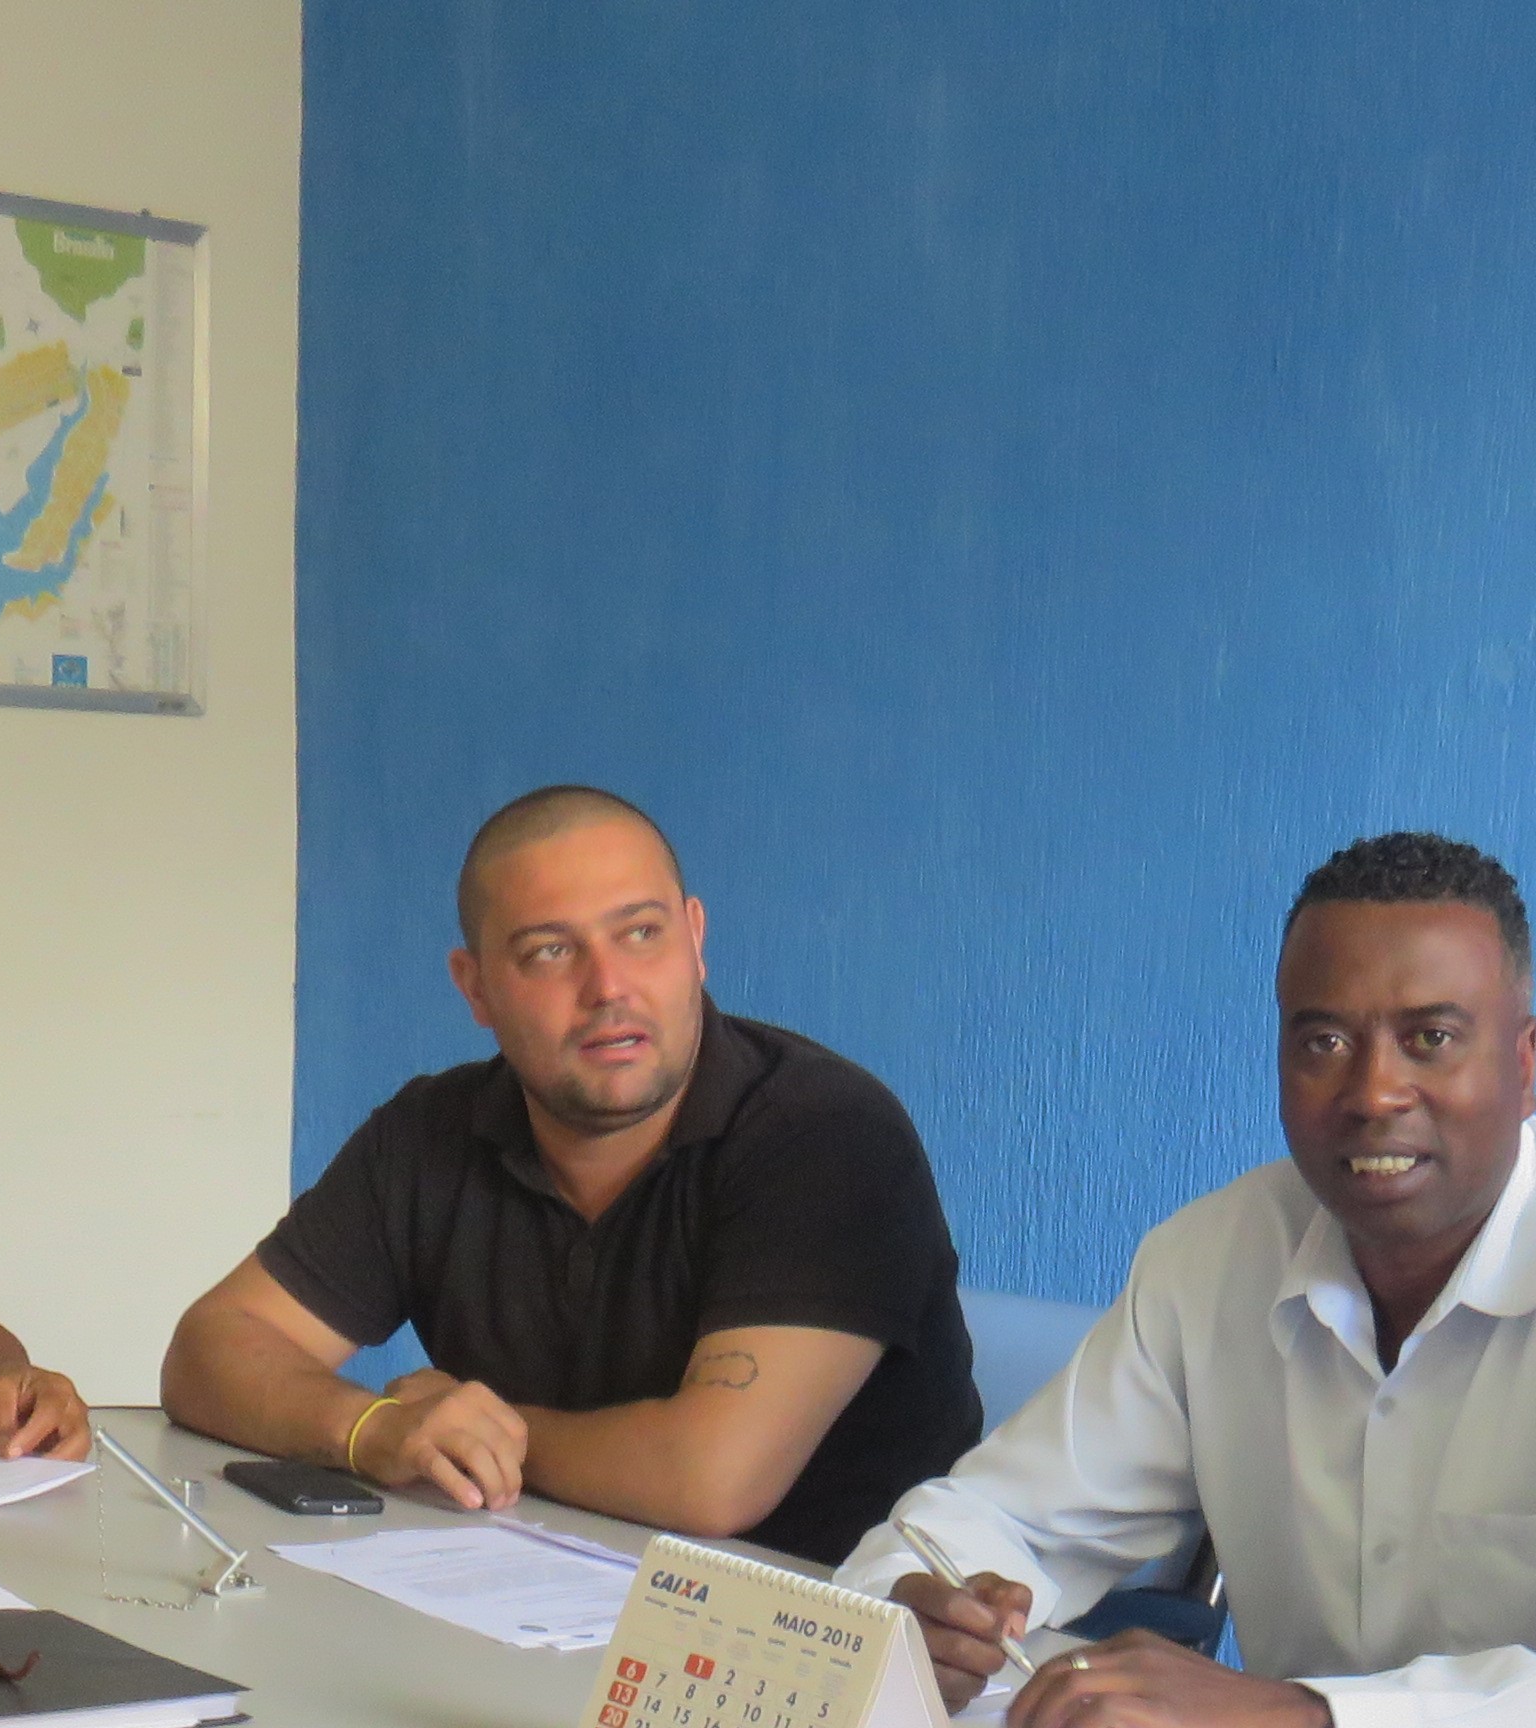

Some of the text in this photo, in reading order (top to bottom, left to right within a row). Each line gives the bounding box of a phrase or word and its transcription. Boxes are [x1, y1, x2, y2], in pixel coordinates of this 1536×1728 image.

[650, 1570, 710, 1603] CAIXA
[772, 1611, 817, 1638] MAIO
[822, 1626, 863, 1653] 2018
[614, 1683, 633, 1704] 13
[643, 1695, 661, 1713] 14
[673, 1706, 691, 1724] 15
[626, 1662, 637, 1679] 6
[655, 1672, 668, 1688] 7
[685, 1683, 696, 1699] 8
[716, 1693, 727, 1709] 9
[743, 1703, 762, 1722] 10
[696, 1658, 829, 1718] 1 2 3 4 5
[603, 1706, 624, 1728] 20
